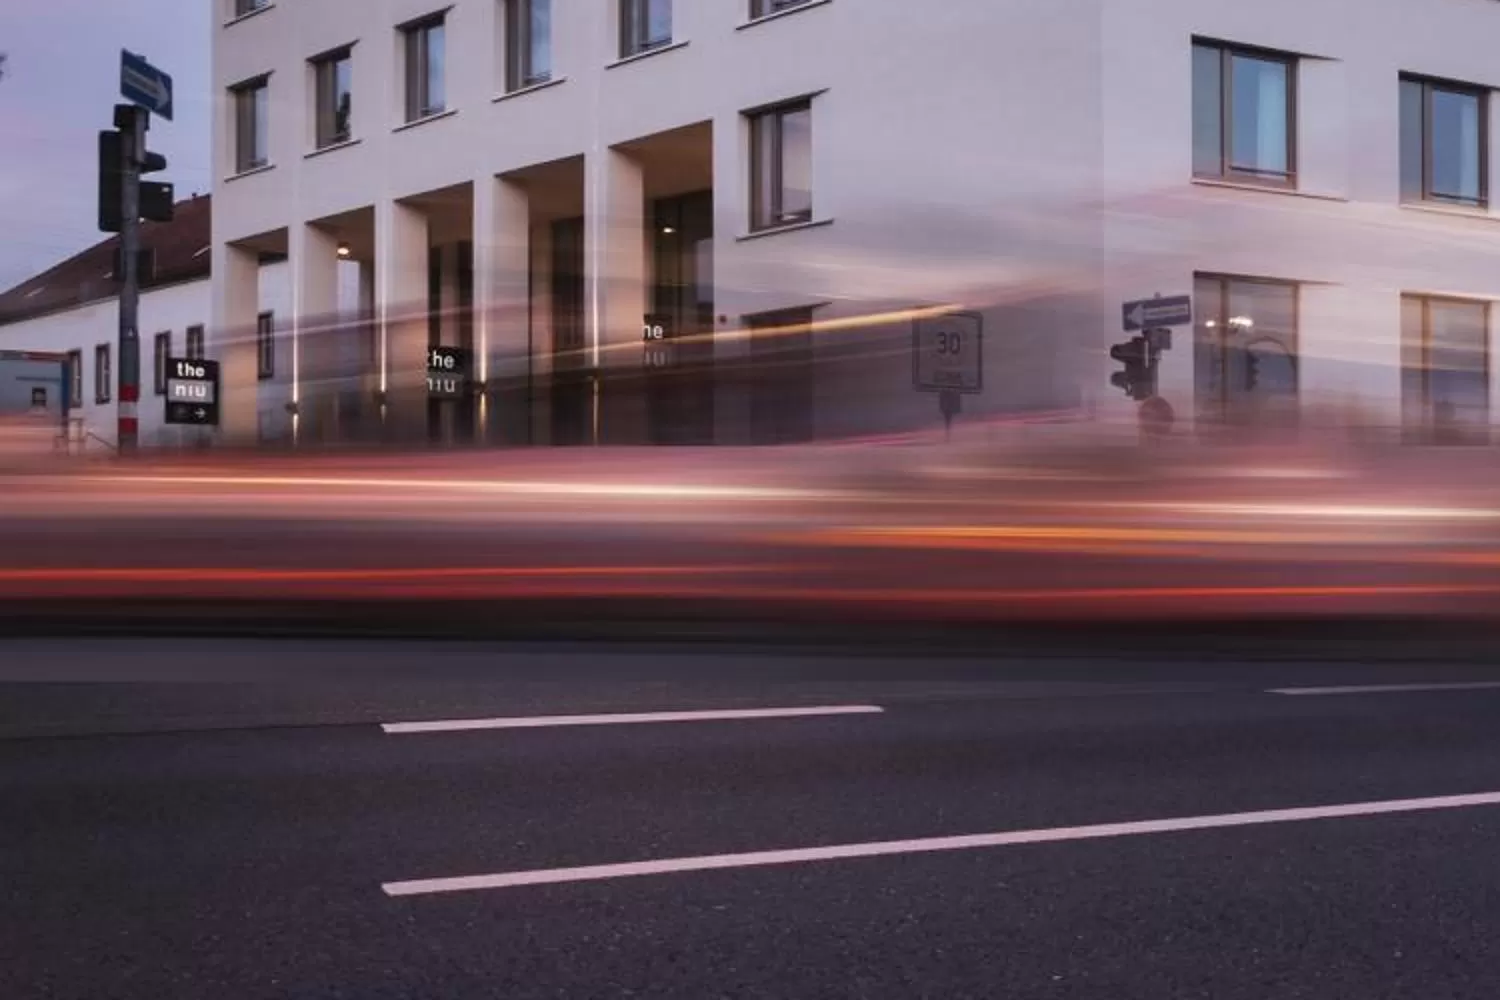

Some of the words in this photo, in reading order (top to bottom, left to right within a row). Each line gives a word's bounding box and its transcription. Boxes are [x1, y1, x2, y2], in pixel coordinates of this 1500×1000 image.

[936, 331, 961, 355] 30
[176, 361, 206, 378] the
[175, 384, 207, 397] niu
